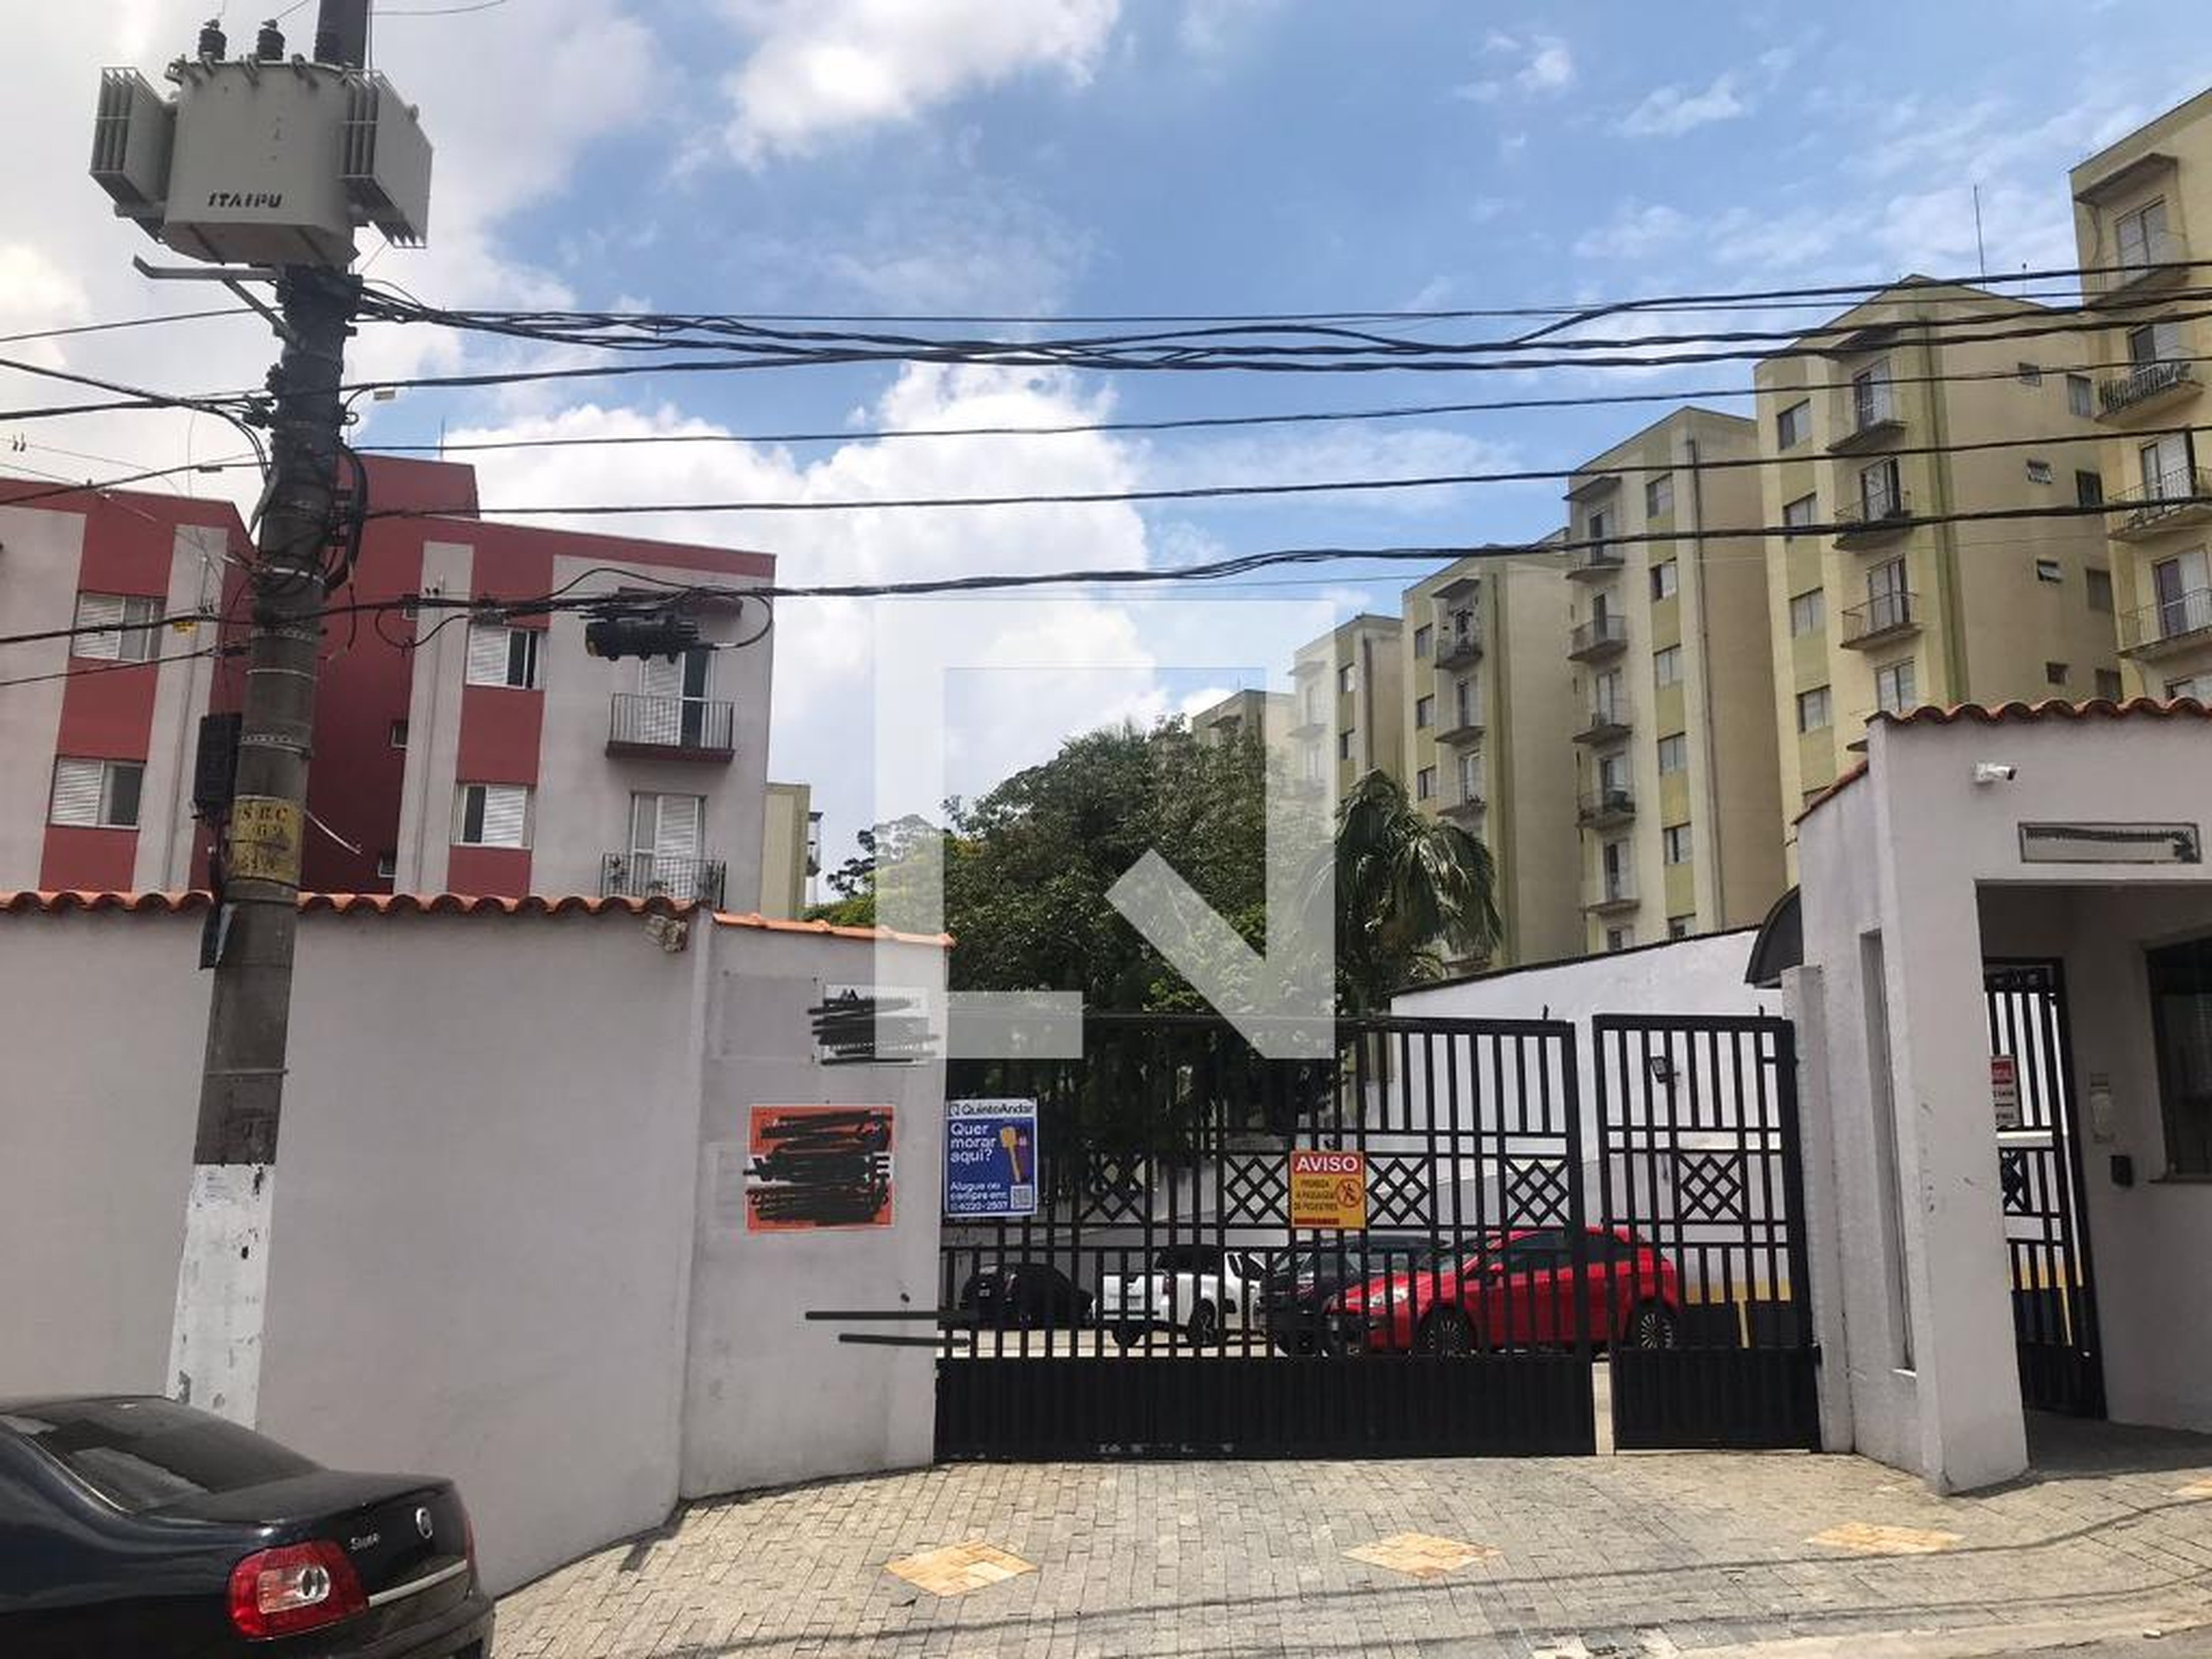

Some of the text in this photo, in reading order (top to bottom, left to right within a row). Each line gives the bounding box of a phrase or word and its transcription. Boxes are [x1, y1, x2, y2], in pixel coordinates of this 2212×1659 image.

[208, 192, 282, 208] ITAIPU
[961, 1103, 1033, 1116] QuintoAndar
[950, 1123, 990, 1136] Quer
[950, 1137, 997, 1149] morar
[950, 1148, 993, 1165] aqui?
[1296, 1156, 1358, 1172] AVISO
